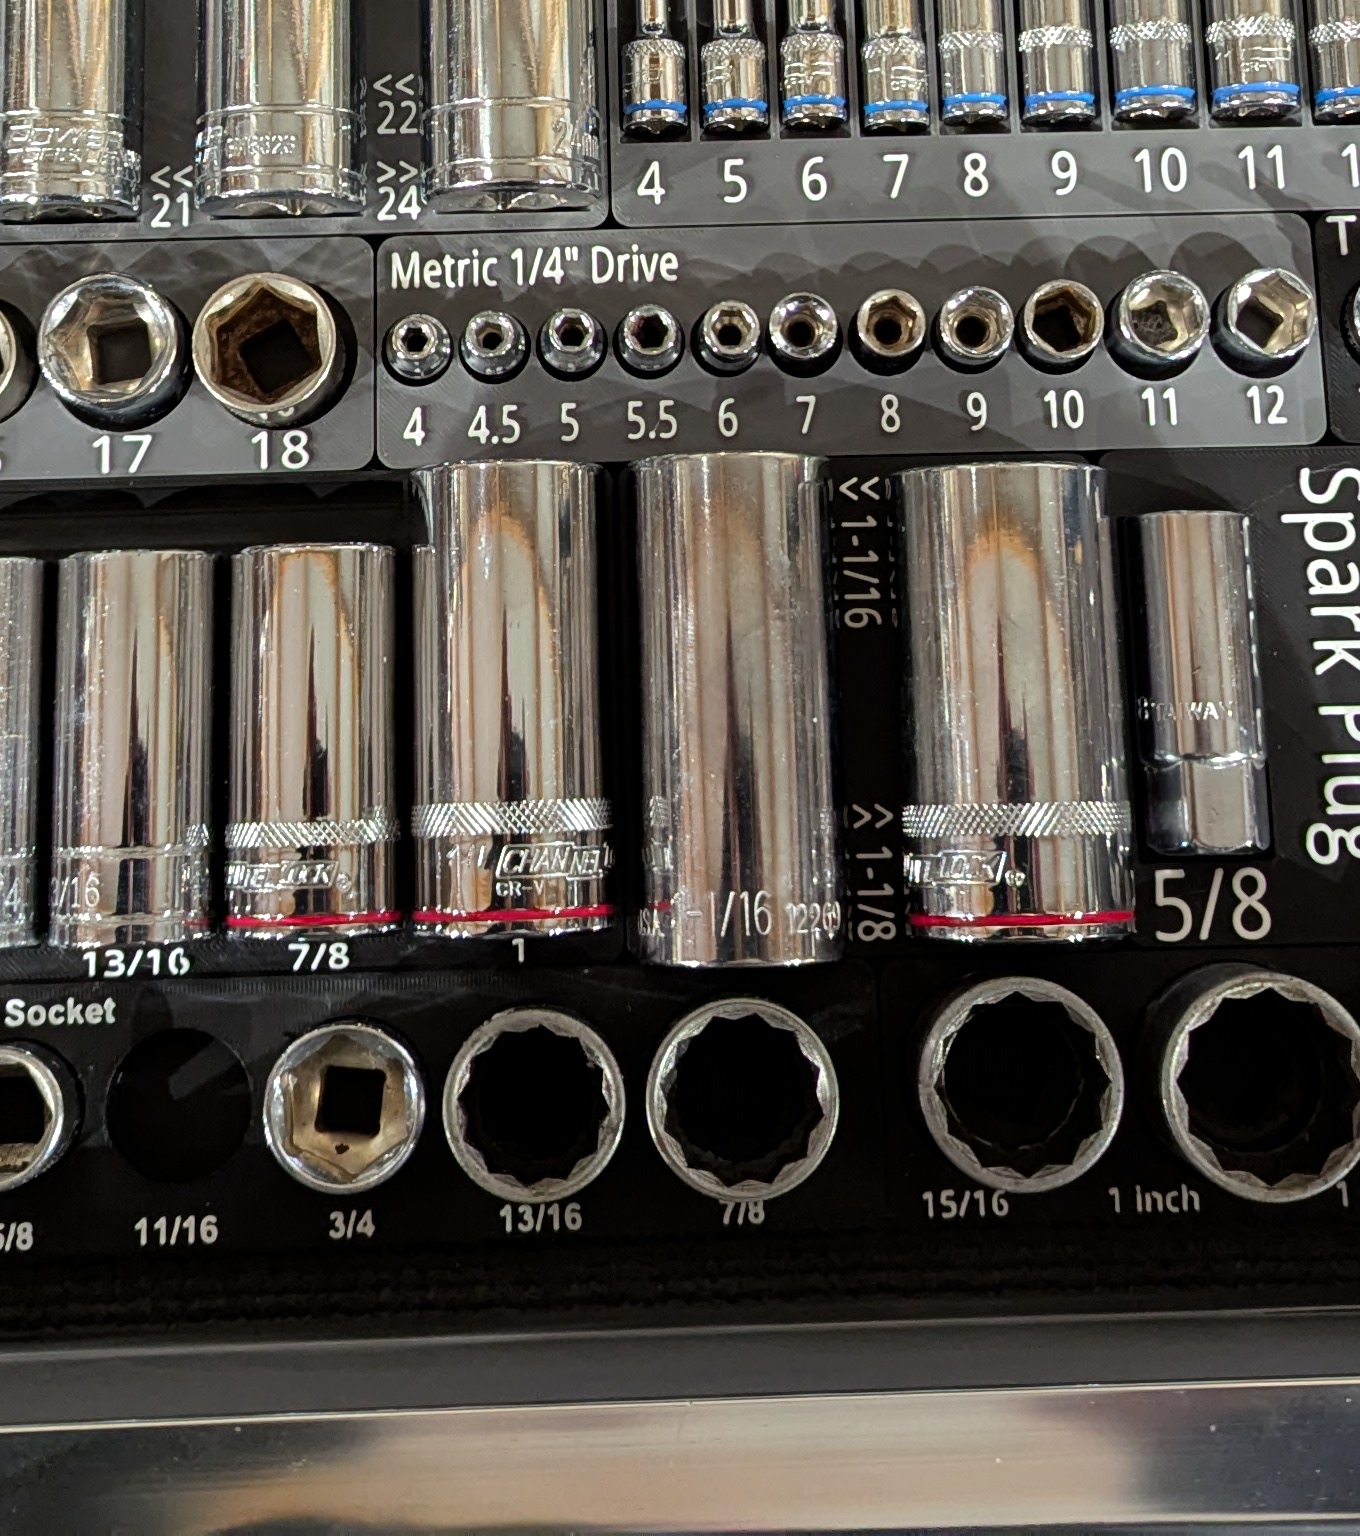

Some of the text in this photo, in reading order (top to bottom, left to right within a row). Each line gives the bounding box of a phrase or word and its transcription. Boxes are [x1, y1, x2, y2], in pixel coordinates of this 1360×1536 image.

[377, 101, 418, 134] 22
[637, 161, 665, 205] 4
[724, 159, 747, 203] 5
[802, 156, 827, 201] 6
[883, 154, 908, 198] 7
[964, 153, 988, 197] 8
[1052, 151, 1077, 195] 9
[1135, 148, 1187, 192] 10
[1239, 145, 1285, 189] 11
[151, 192, 189, 228] 21
[378, 186, 422, 222] 24
[392, 244, 678, 289] Metric 1/4" Drive
[403, 385, 1287, 446] 4 4.5 5 5.5 6 7 8 9 10 11 12
[92, 435, 152, 474] 17
[251, 430, 309, 470] 18
[839, 516, 880, 629] 1-1/16
[854, 848, 898, 942] 1-1/8
[1155, 867, 1271, 942] 5/8
[82, 948, 190, 978] 13/16
[287, 942, 350, 971] 7/8
[512, 938, 524, 962] 1
[5, 997, 116, 1027] Socket
[500, 1203, 582, 1232] 13/16
[720, 1201, 766, 1224] 7/8
[922, 1189, 1009, 1218] 15/16
[135, 1215, 218, 1246] 11/16
[329, 1210, 375, 1239] 3/4
